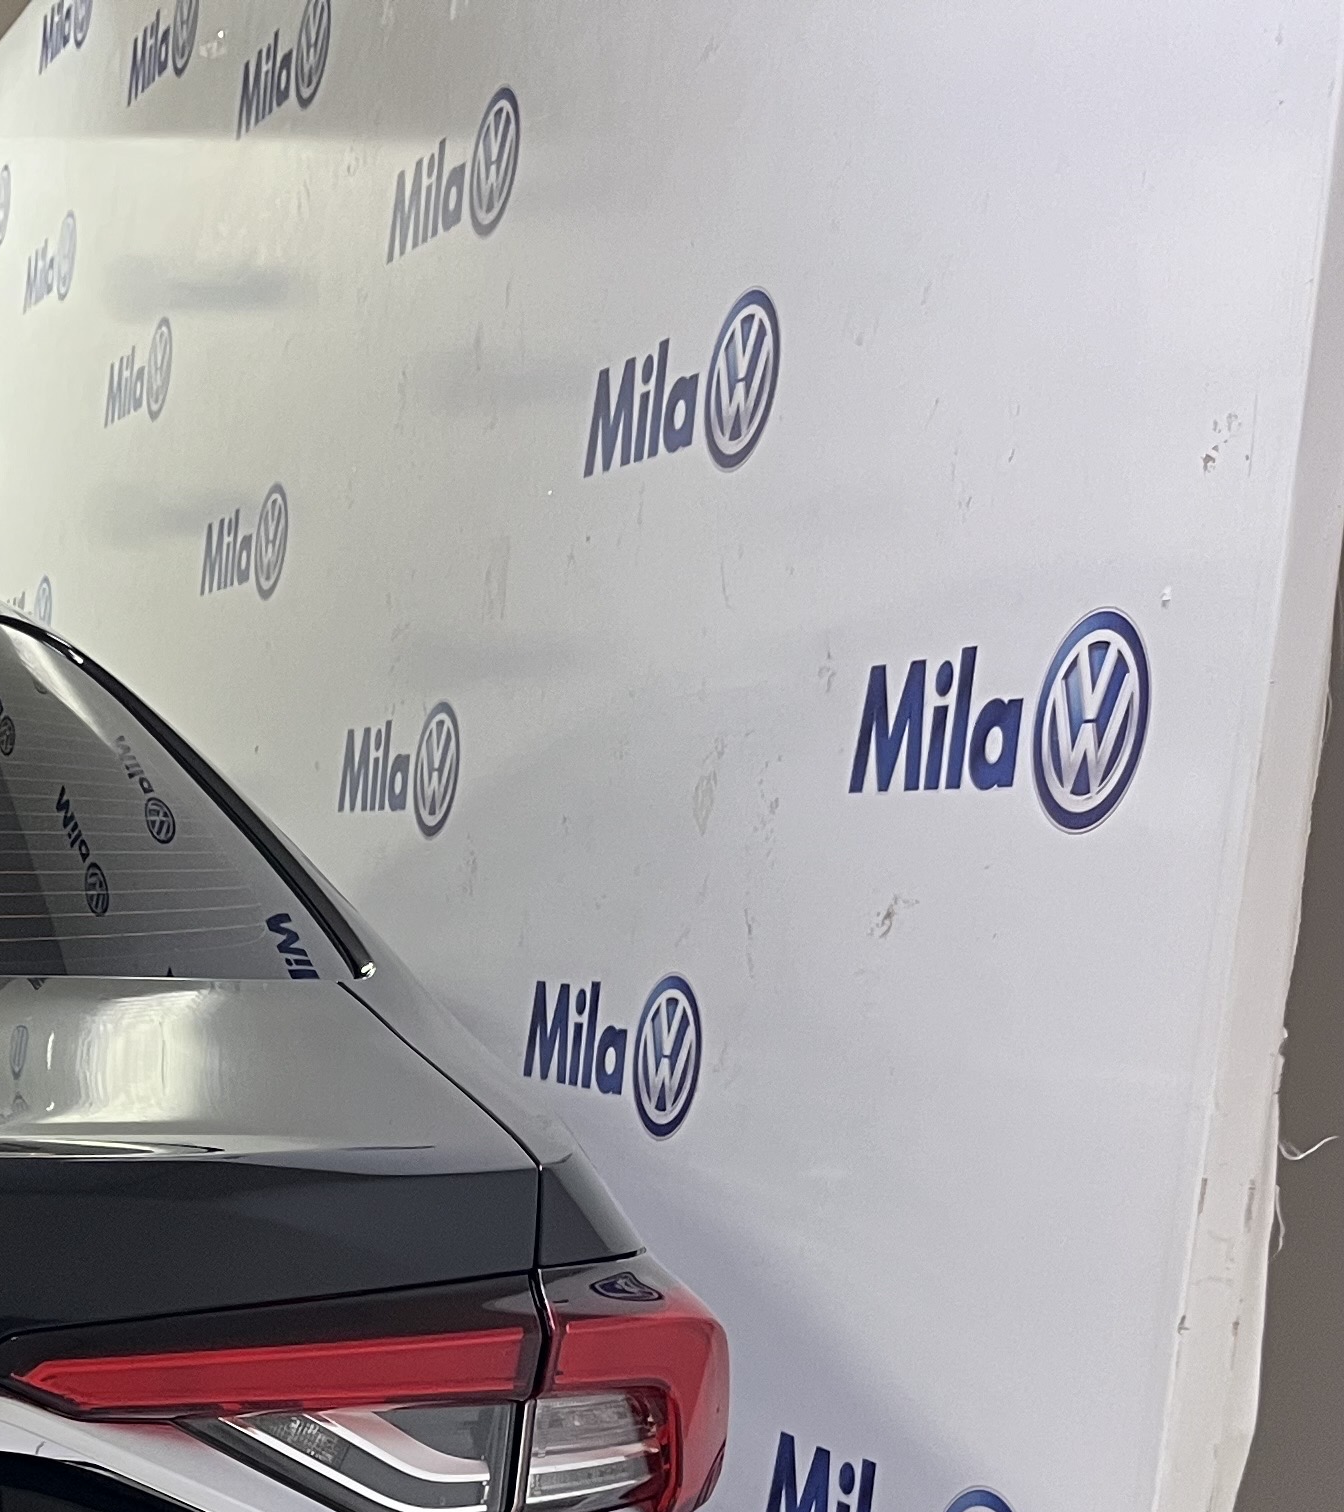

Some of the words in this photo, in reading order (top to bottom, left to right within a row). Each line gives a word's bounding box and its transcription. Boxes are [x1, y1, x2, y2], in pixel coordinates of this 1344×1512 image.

[127, 9, 170, 107] Mila
[236, 27, 293, 140] Mila
[386, 138, 466, 265] Mila
[105, 345, 144, 428] Mila
[583, 337, 700, 479] Mila
[201, 508, 253, 596] Mila
[338, 720, 410, 812] Mila
[848, 645, 1024, 794] Mila
[523, 980, 627, 1096] Mila
